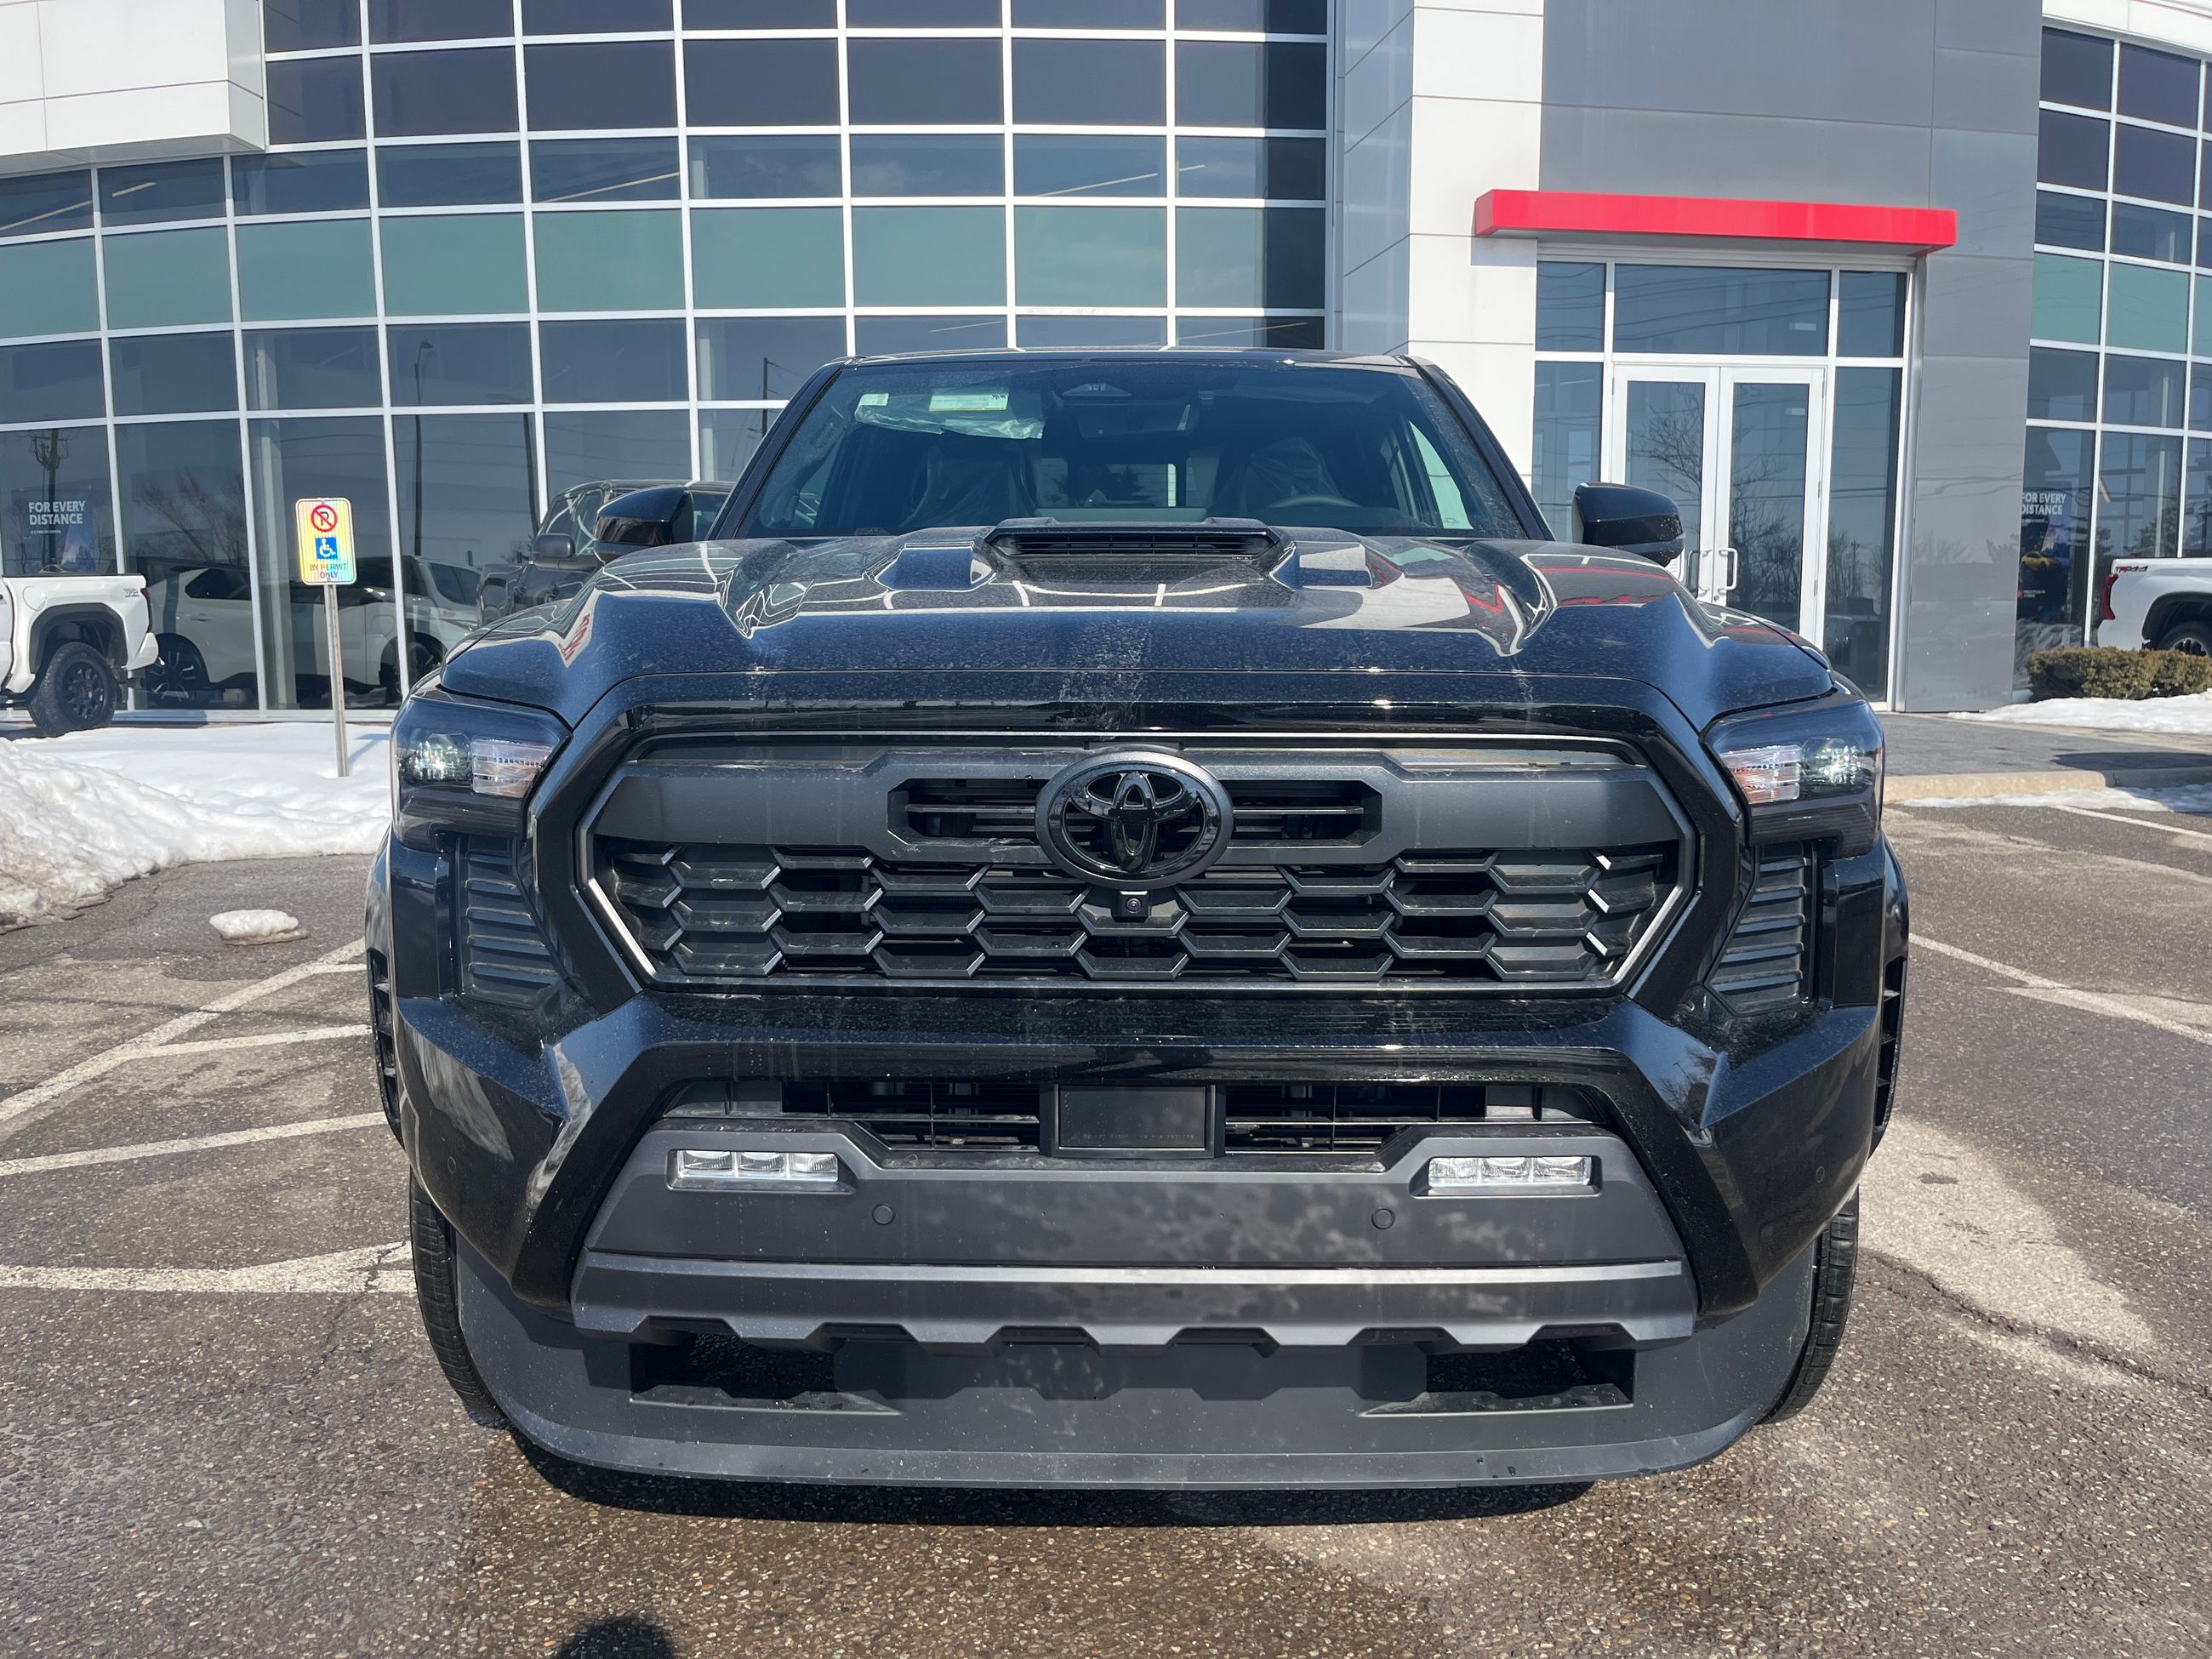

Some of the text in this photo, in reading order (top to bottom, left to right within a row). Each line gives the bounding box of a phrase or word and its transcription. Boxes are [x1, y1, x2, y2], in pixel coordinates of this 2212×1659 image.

[2039, 493, 2067, 504] EVERY
[29, 500, 85, 512] FOR EVERY
[2021, 505, 2062, 515] DISTANCE
[30, 513, 83, 525] DISTANCE
[321, 562, 347, 571] PERMIT
